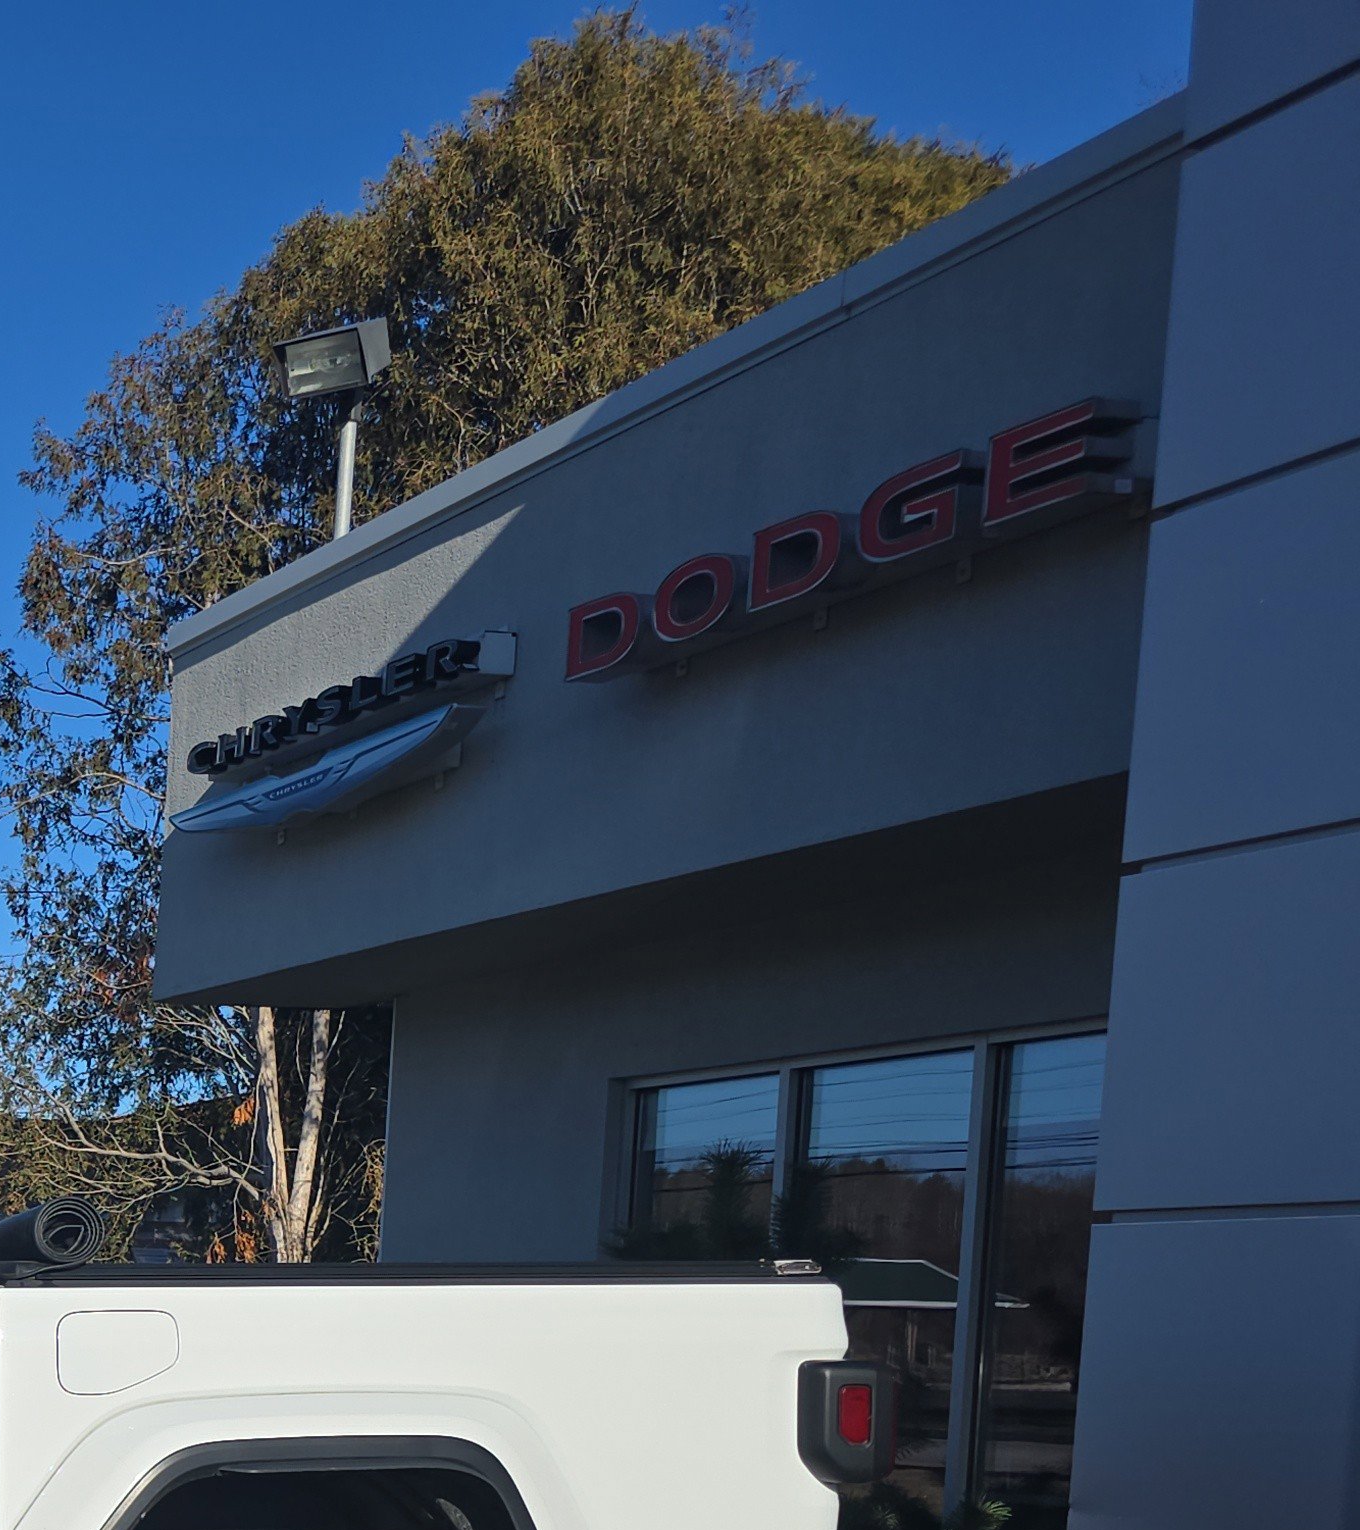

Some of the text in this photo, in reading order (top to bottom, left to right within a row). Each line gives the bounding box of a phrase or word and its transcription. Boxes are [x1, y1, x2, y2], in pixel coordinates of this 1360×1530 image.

[565, 401, 1095, 683] DODGE
[186, 640, 463, 774] CHRYSLER
[269, 774, 324, 799] CHRYSLER
